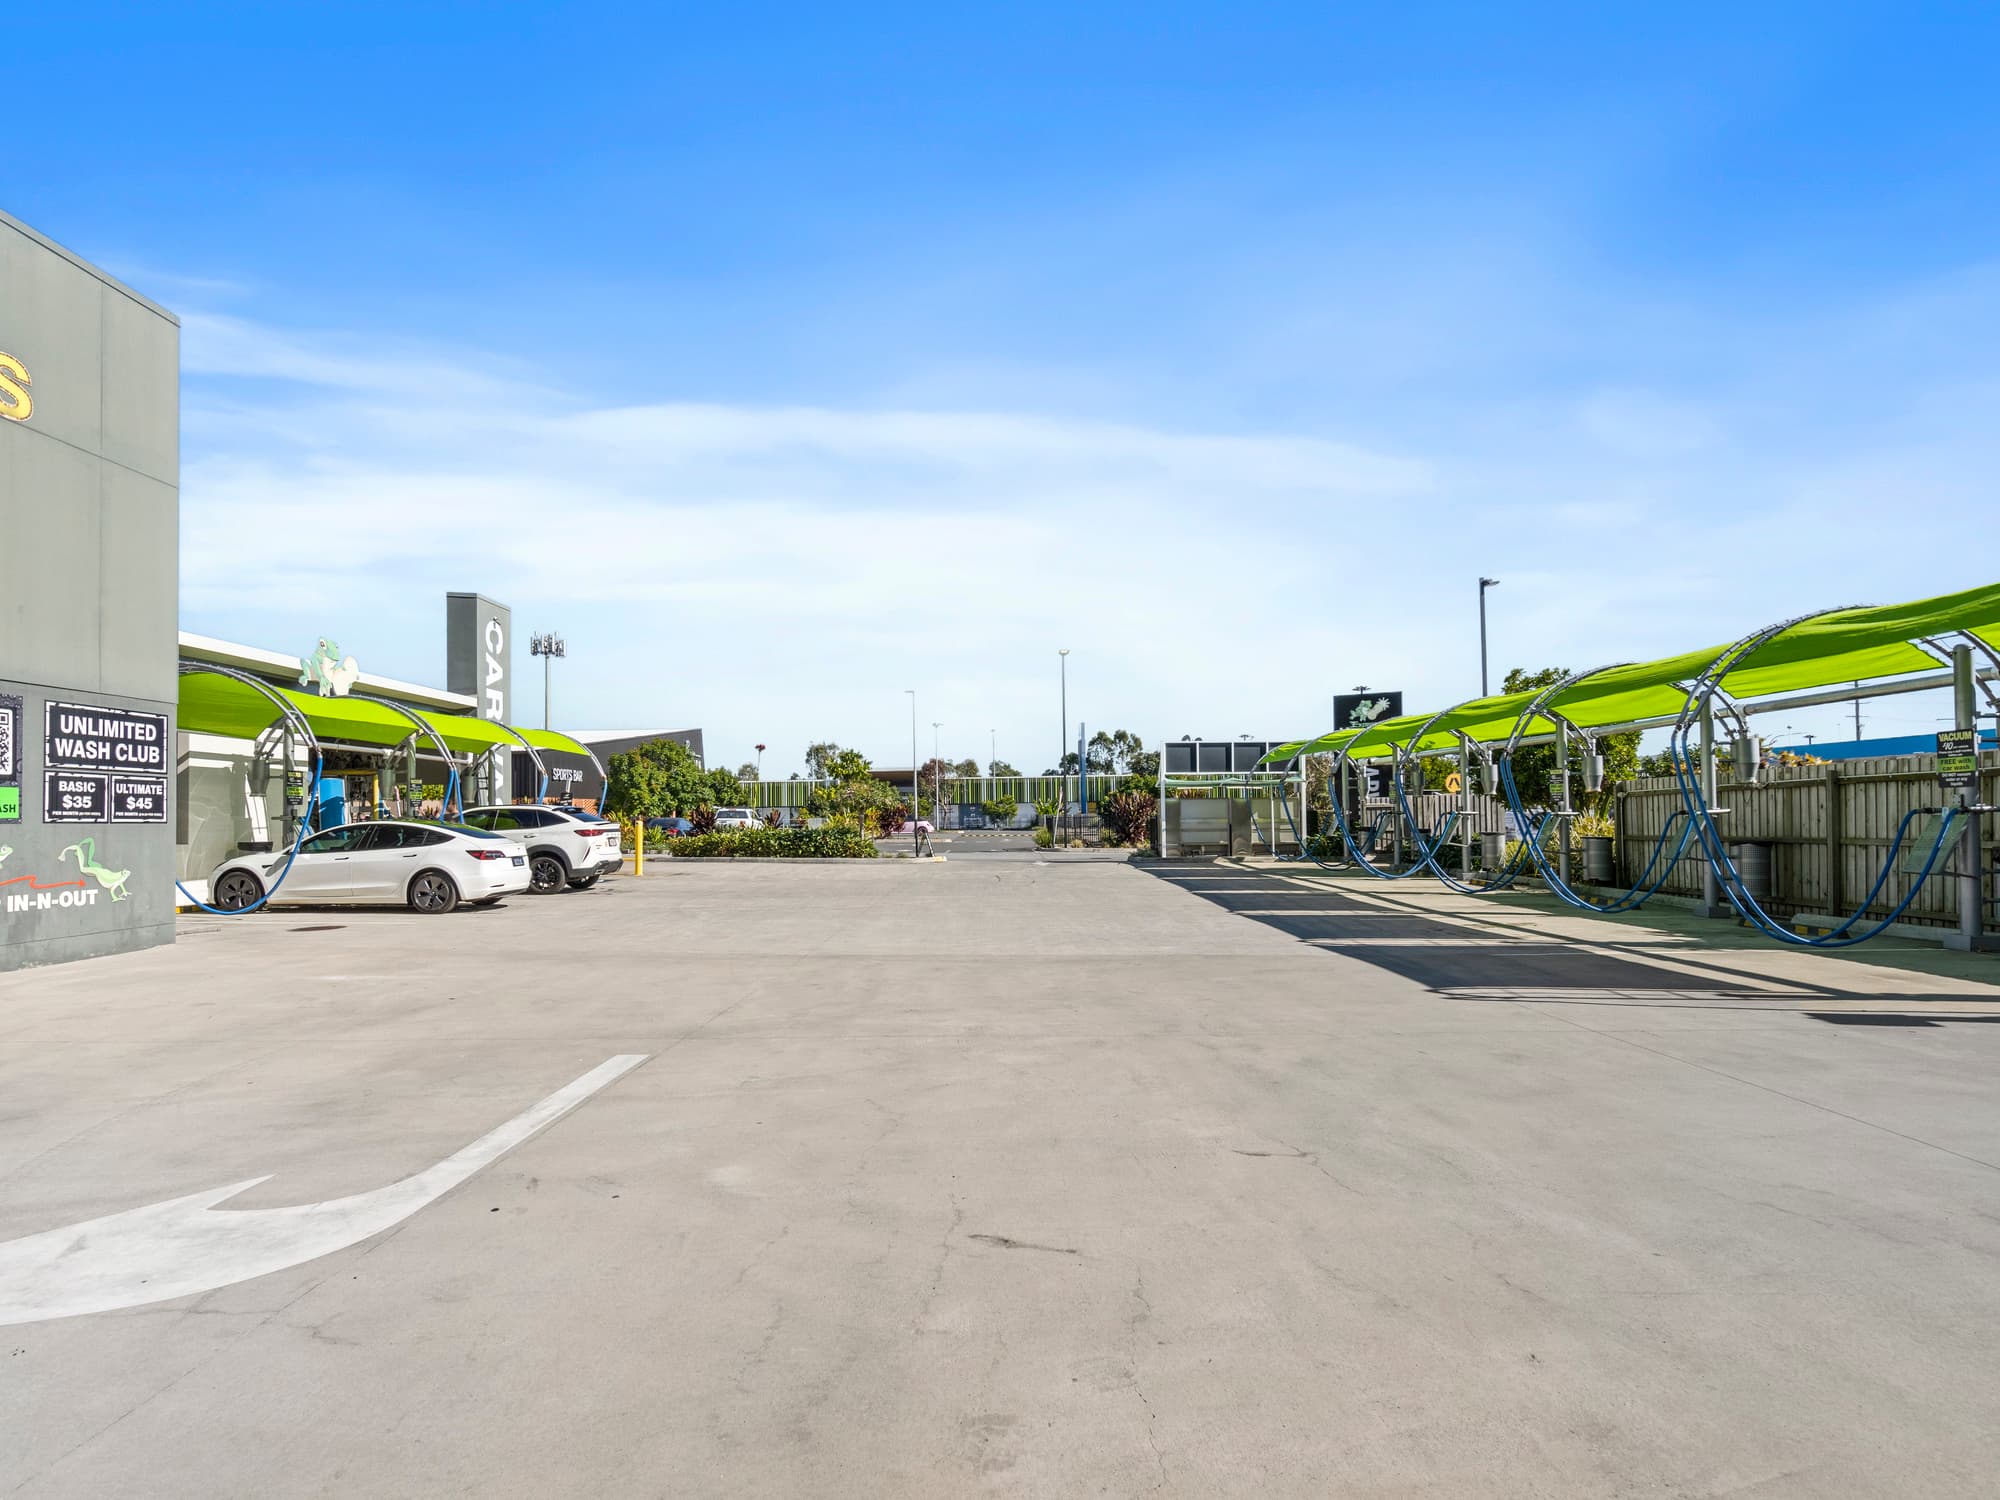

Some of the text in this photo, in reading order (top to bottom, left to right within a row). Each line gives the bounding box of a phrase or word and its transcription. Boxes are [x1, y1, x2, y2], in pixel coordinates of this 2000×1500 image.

[486, 619, 504, 723] CAR
[60, 714, 157, 741] UNLIMITED
[1938, 731, 1972, 742] VACUUM
[55, 738, 160, 763] WASH CLUB
[552, 768, 583, 781] SPORTS BAR
[59, 781, 96, 793] BASIC
[115, 783, 163, 795] ULTIMATE
[62, 794, 92, 810] $35
[126, 796, 153, 810] $45
[7, 889, 98, 912] IN-N-OUT
